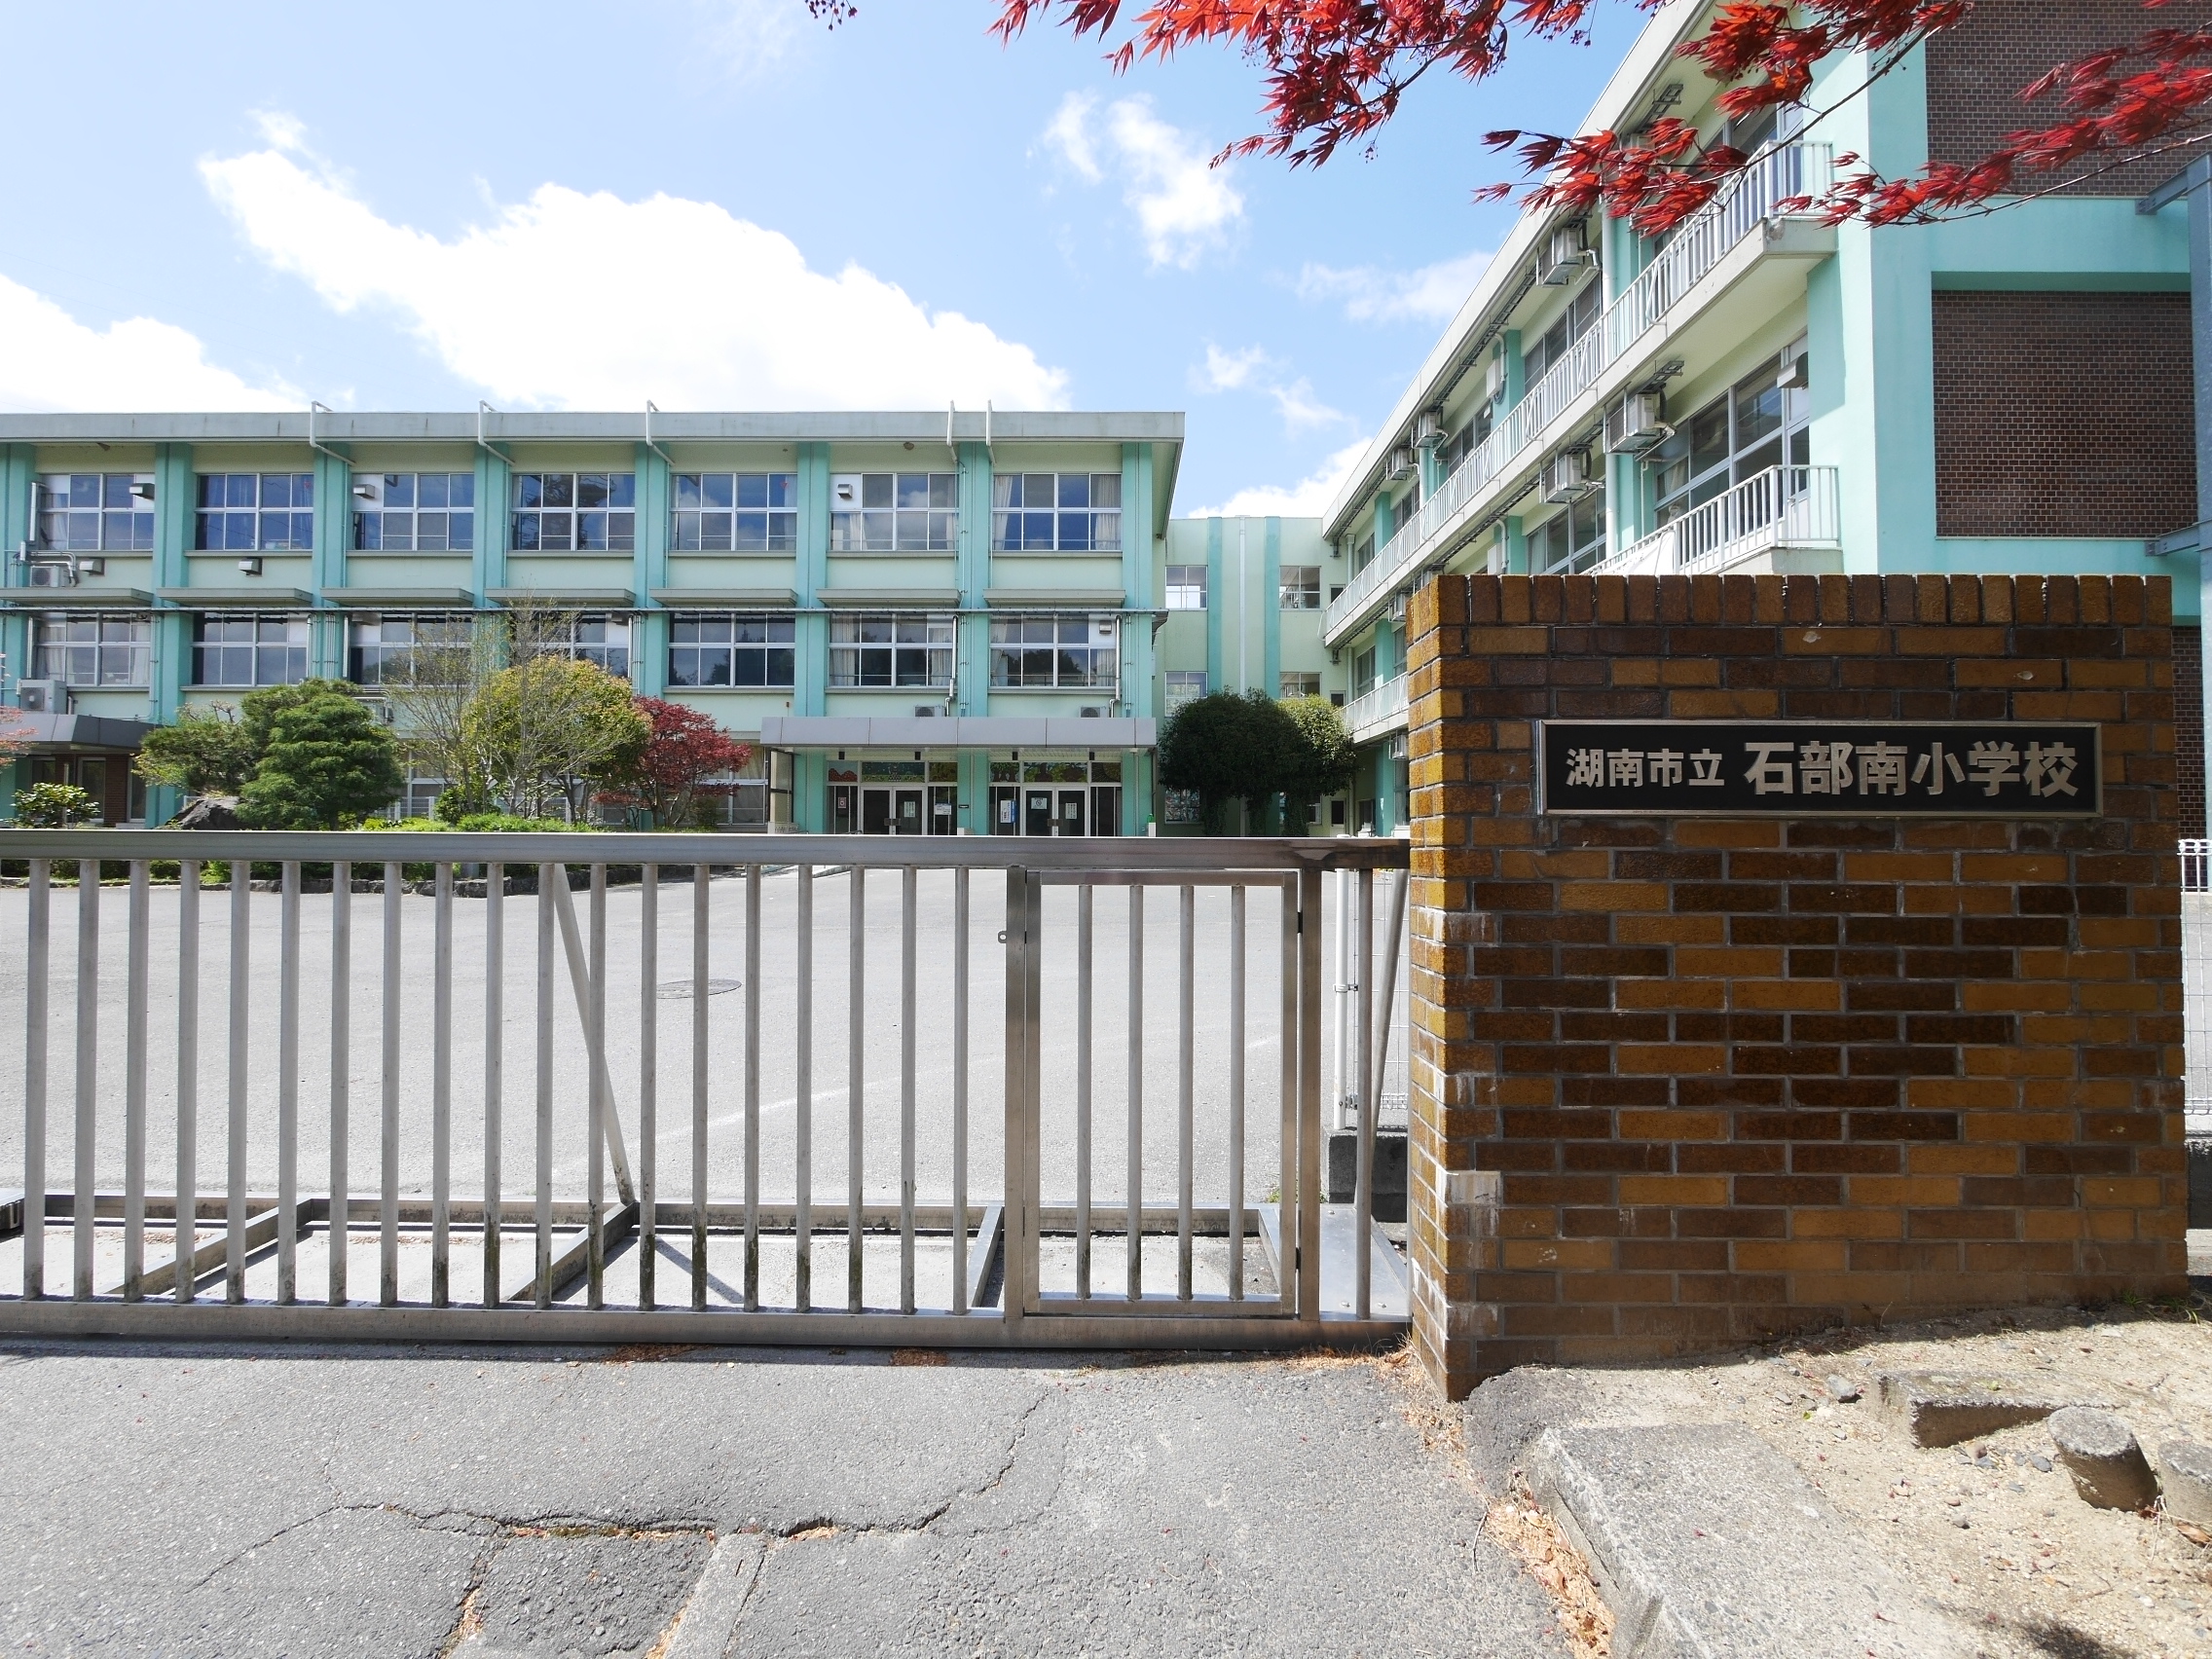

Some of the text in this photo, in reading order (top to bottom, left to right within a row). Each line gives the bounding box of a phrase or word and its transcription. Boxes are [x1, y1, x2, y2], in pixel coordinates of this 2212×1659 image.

[1566, 740, 2079, 796] 湖南市立 石部南小学校
